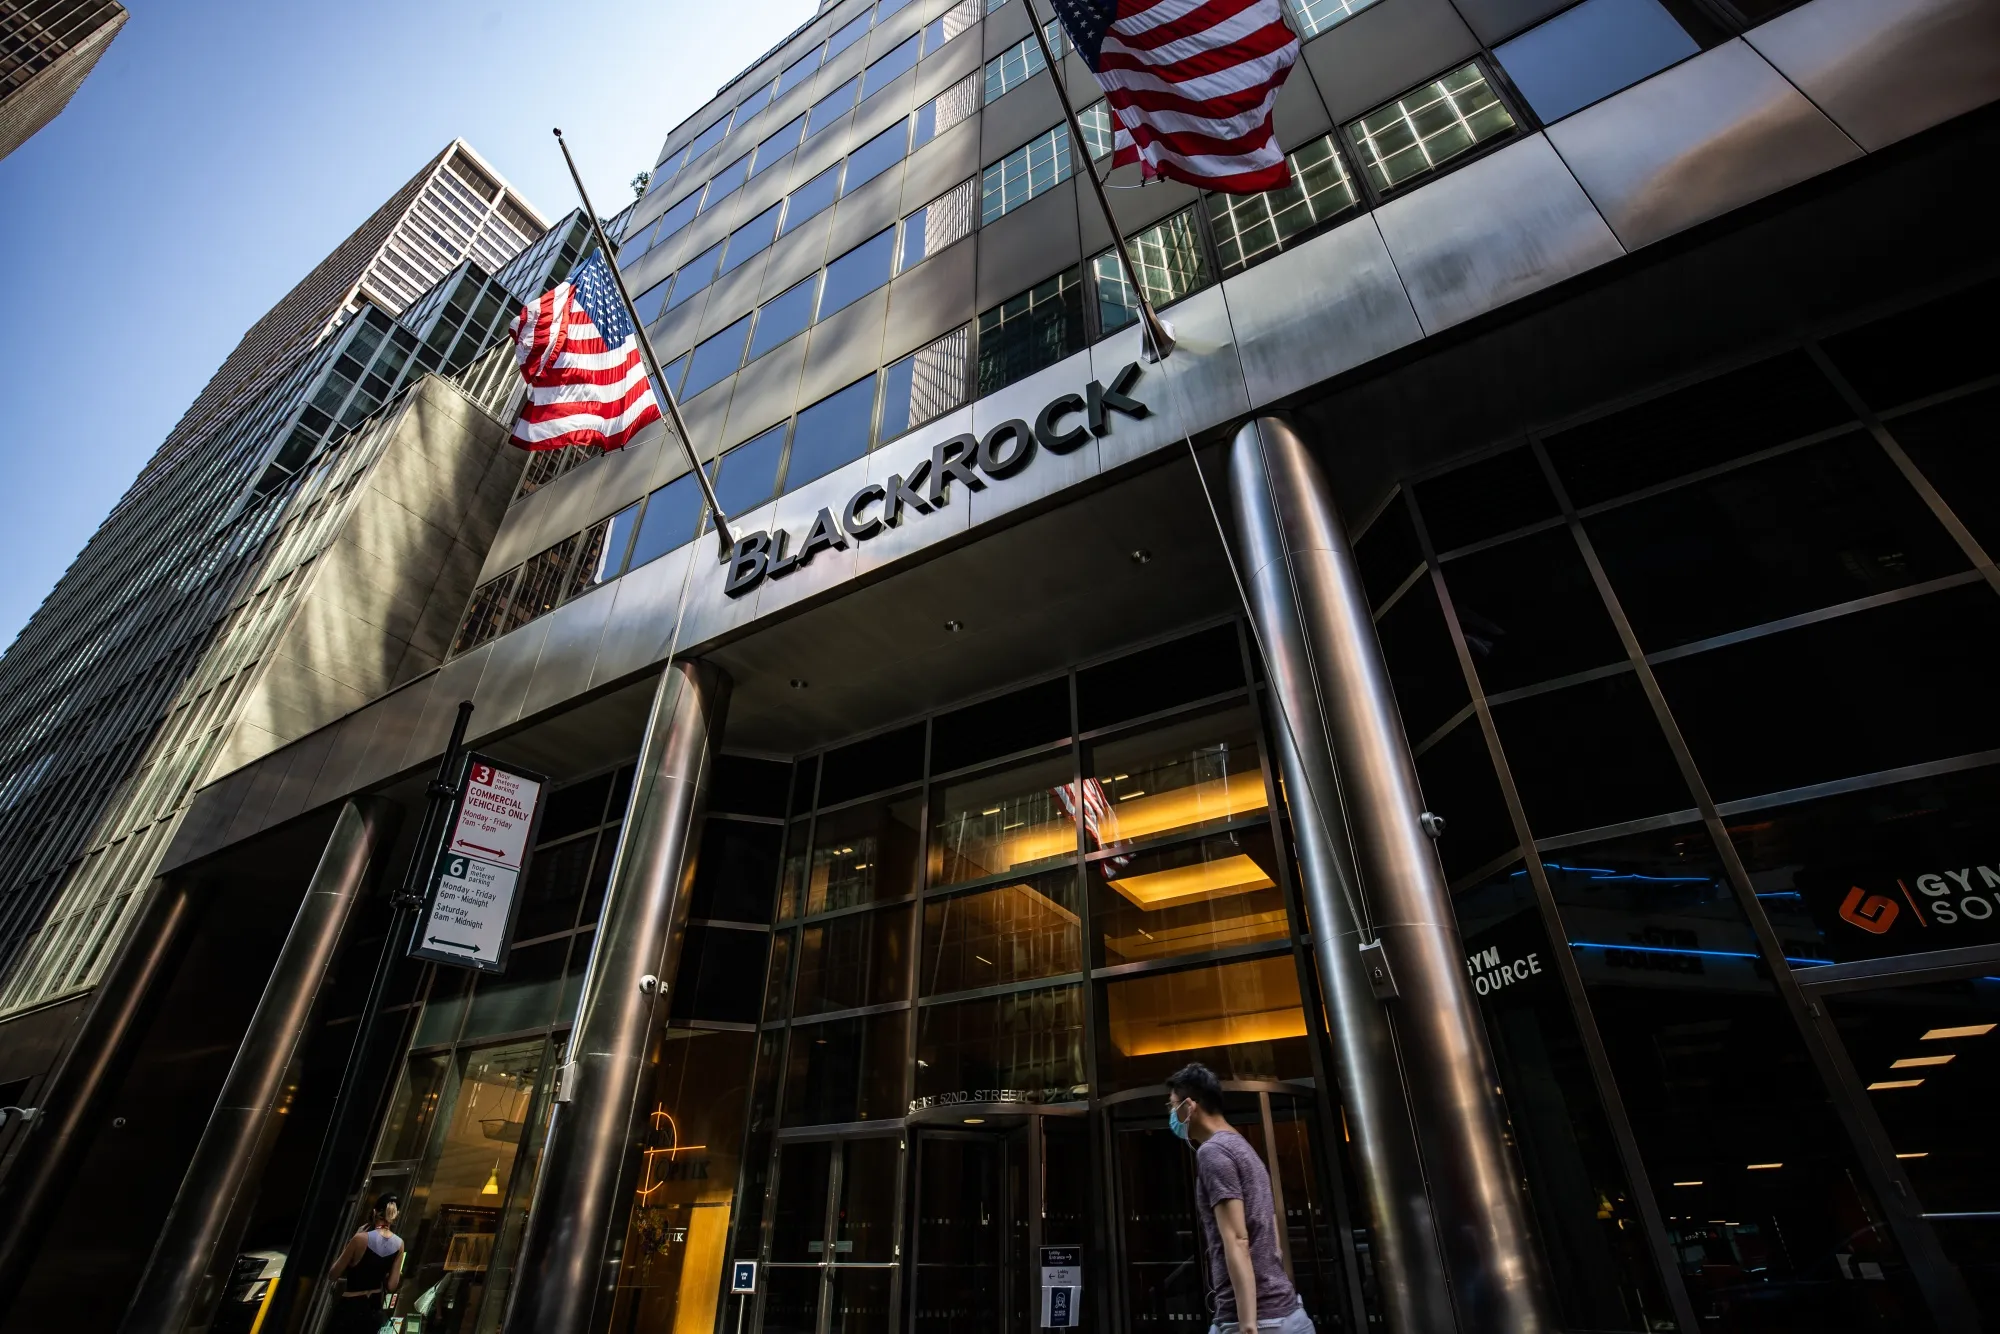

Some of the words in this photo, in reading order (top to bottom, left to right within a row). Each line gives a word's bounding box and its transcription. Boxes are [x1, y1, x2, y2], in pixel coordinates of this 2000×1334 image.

[723, 361, 1154, 599] BLACKROCK
[476, 766, 490, 783] 3
[497, 772, 510, 780] hour
[494, 785, 515, 796] parking
[496, 779, 519, 789] metered
[470, 787, 522, 810] COMMERCIAL
[468, 797, 506, 815] VEHICLES
[508, 809, 529, 821] ONLY
[461, 817, 476, 827] 7am
[481, 822, 497, 833] 6pm
[463, 809, 488, 822] Monday
[493, 817, 512, 830] Friday
[450, 858, 464, 876] 6
[471, 864, 486, 872] hour
[468, 877, 490, 887] parking
[470, 871, 495, 881] metered
[440, 890, 456, 900] 6pm
[461, 895, 489, 908] Midnight
[442, 881, 470, 895] Monday
[475, 889, 497, 901] Friday
[436, 902, 469, 918] Saturday
[1931, 892, 2000, 924] SO
[433, 911, 450, 922] 8am
[455, 917, 483, 930] Midnight
[1475, 952, 1542, 996] OURCE
[939, 1090, 968, 1105] 52ND
[974, 1088, 1025, 1102] STREET
